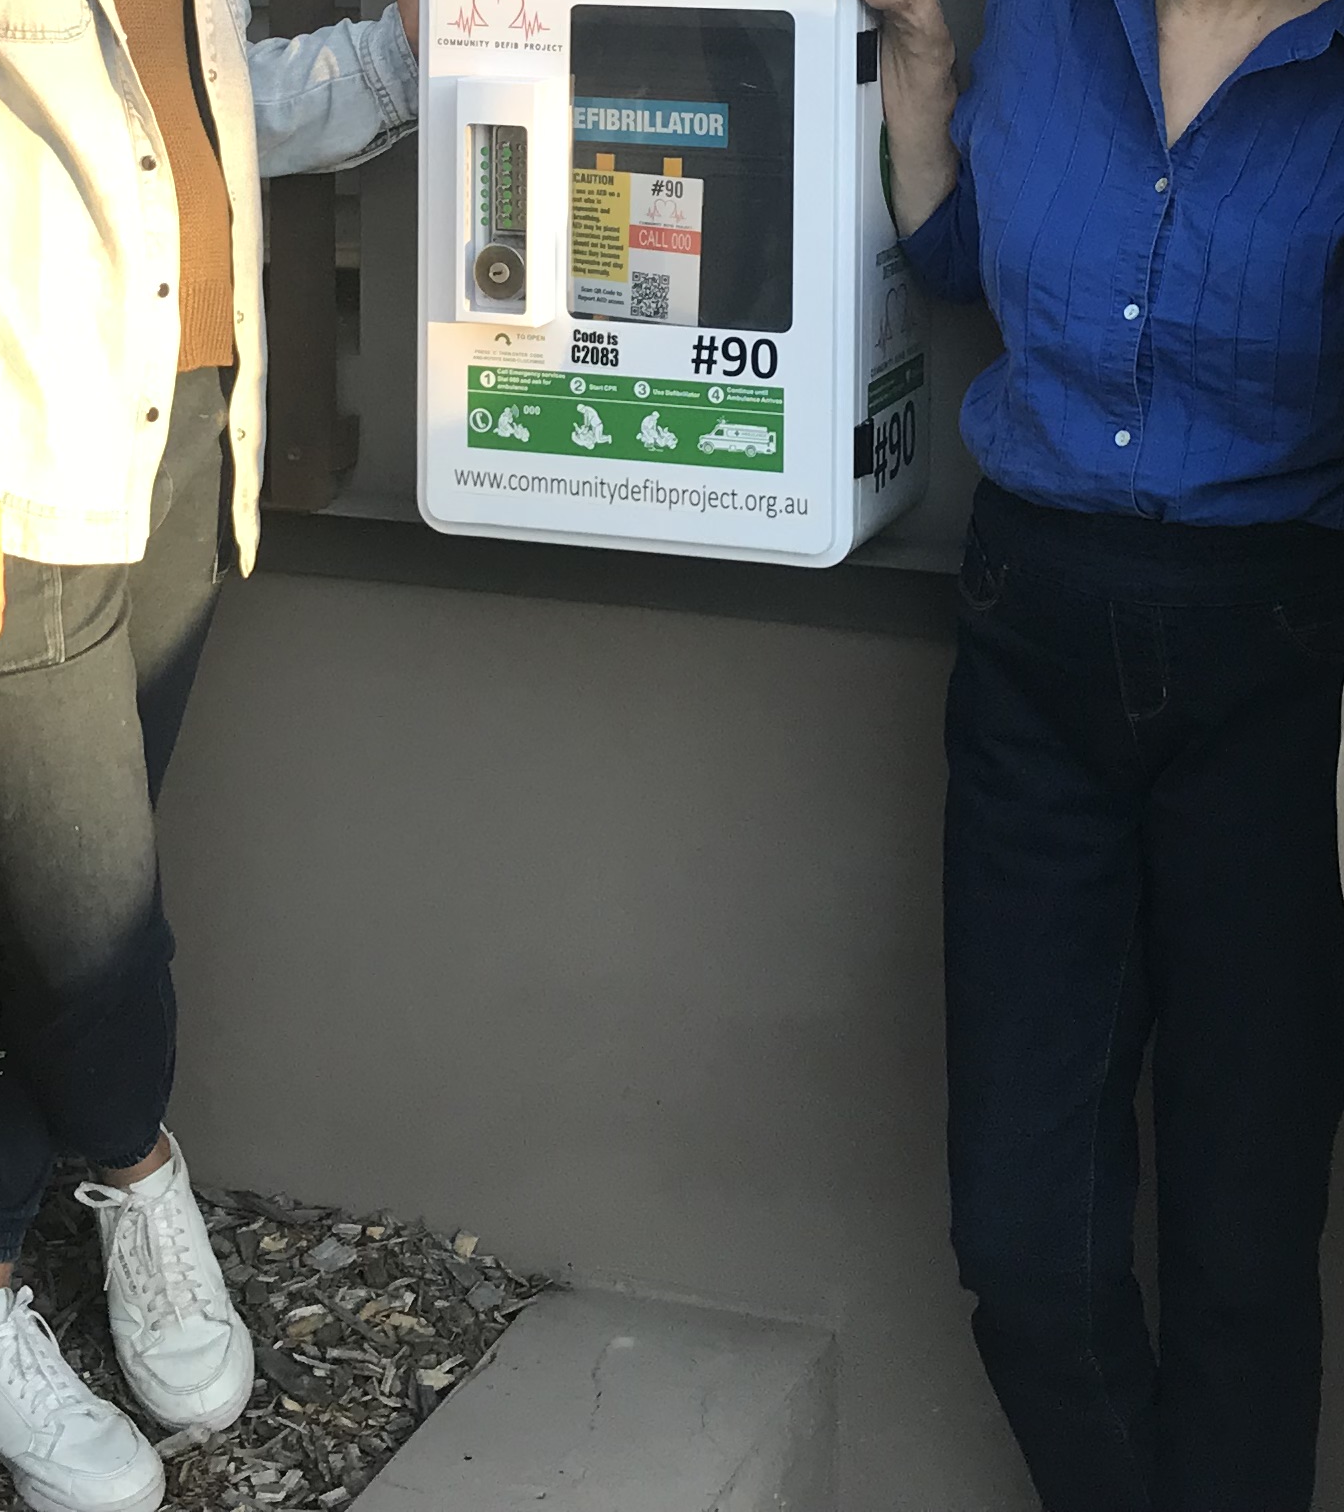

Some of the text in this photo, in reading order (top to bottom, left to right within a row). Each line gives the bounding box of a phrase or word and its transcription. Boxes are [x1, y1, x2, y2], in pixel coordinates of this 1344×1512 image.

[437, 38, 564, 52] COMMUNITY DEFIB PROJECT
[571, 107, 725, 137] EFIBRILLATOR
[573, 172, 614, 186] CAUTION
[651, 179, 684, 199] #90
[638, 229, 668, 248] CALL
[671, 233, 692, 251] 000
[516, 333, 546, 342] TO OPEN
[573, 328, 619, 346] Code is
[571, 344, 619, 368] C2083
[691, 333, 778, 380] #90
[509, 369, 541, 379] Emergency
[523, 404, 541, 416] 000
[873, 400, 917, 494] #90
[454, 468, 809, 519] www.communitydefibproject.org.au
